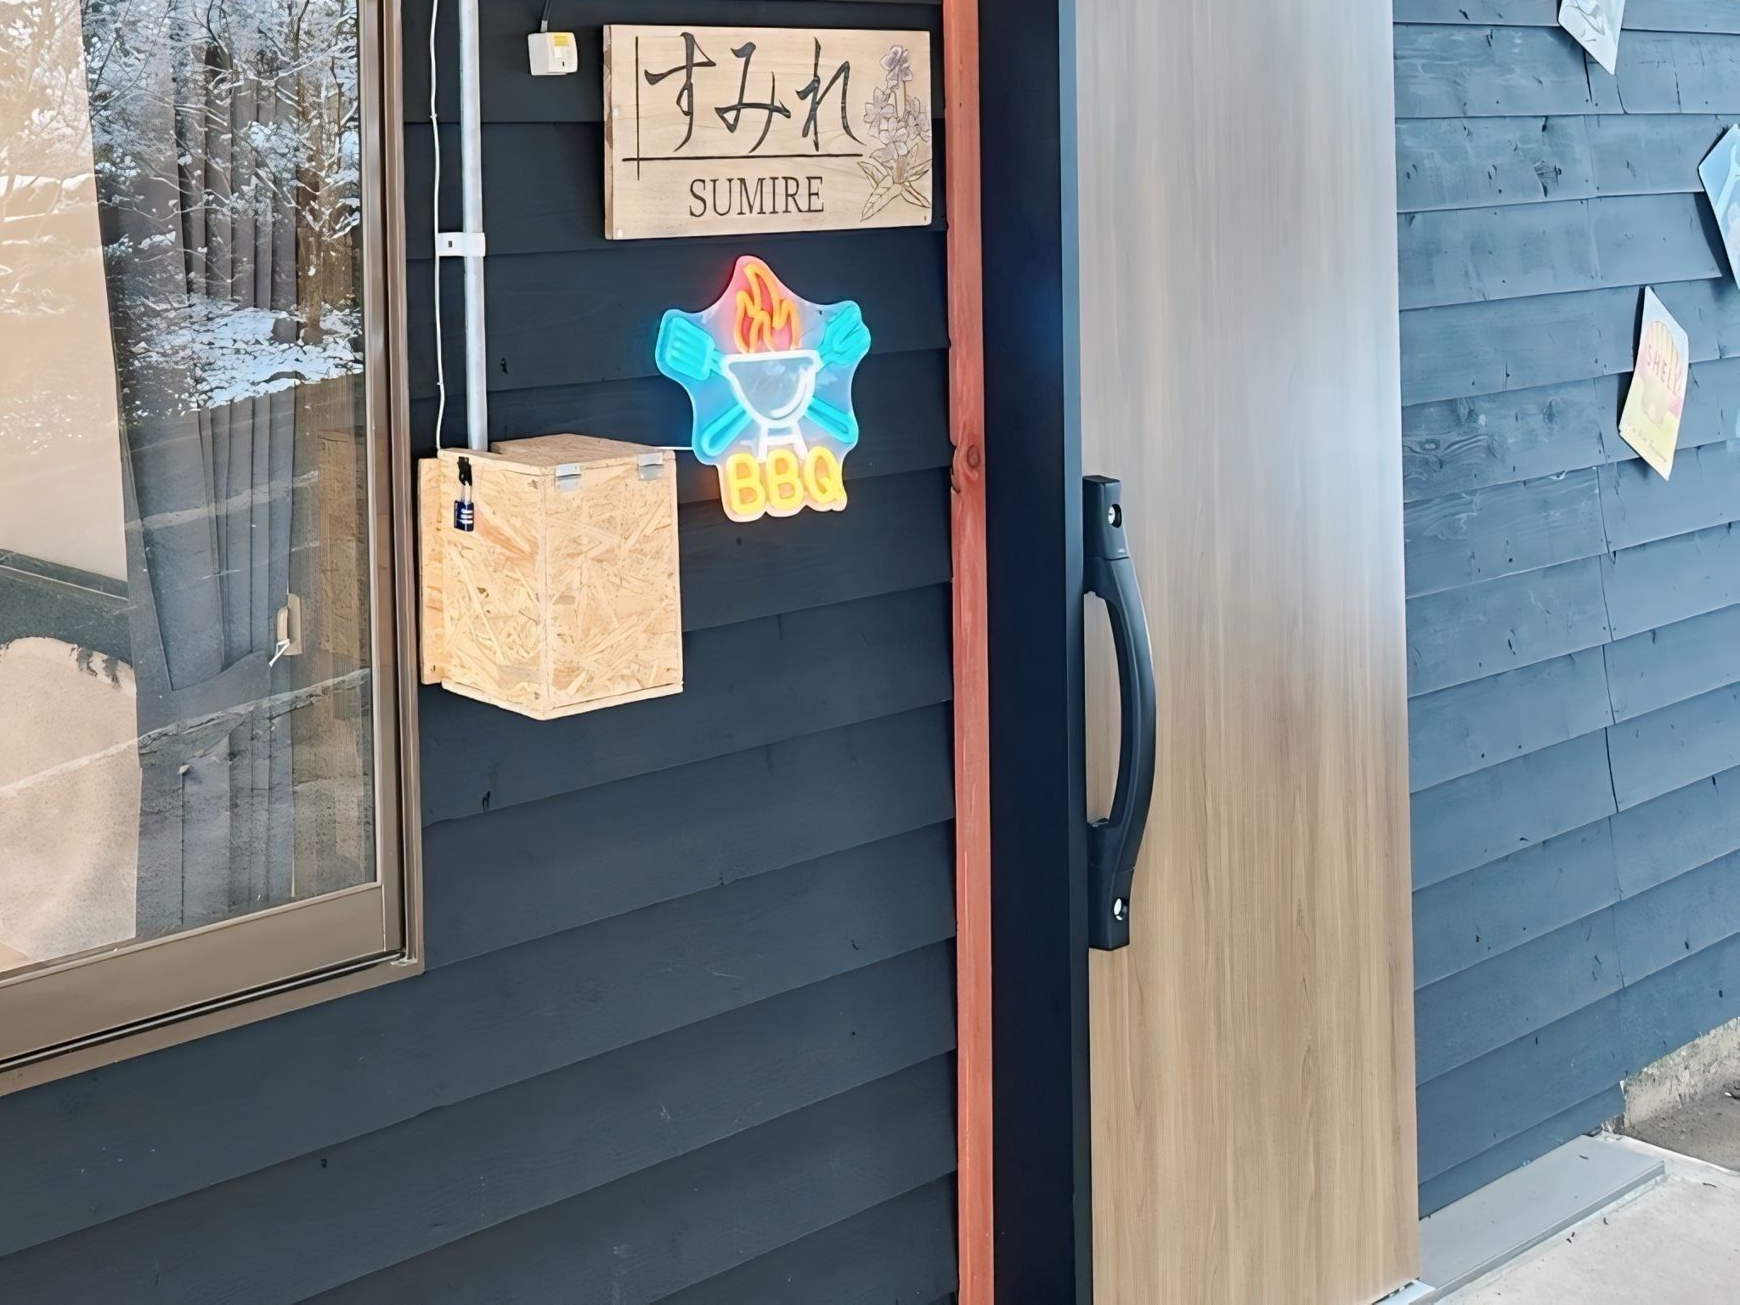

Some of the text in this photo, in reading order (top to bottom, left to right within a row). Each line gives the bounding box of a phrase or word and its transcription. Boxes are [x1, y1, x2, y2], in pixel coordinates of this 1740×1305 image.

[643, 31, 867, 154] すみれ
[689, 176, 825, 218] SUMIRE
[726, 445, 845, 515] BBQ
